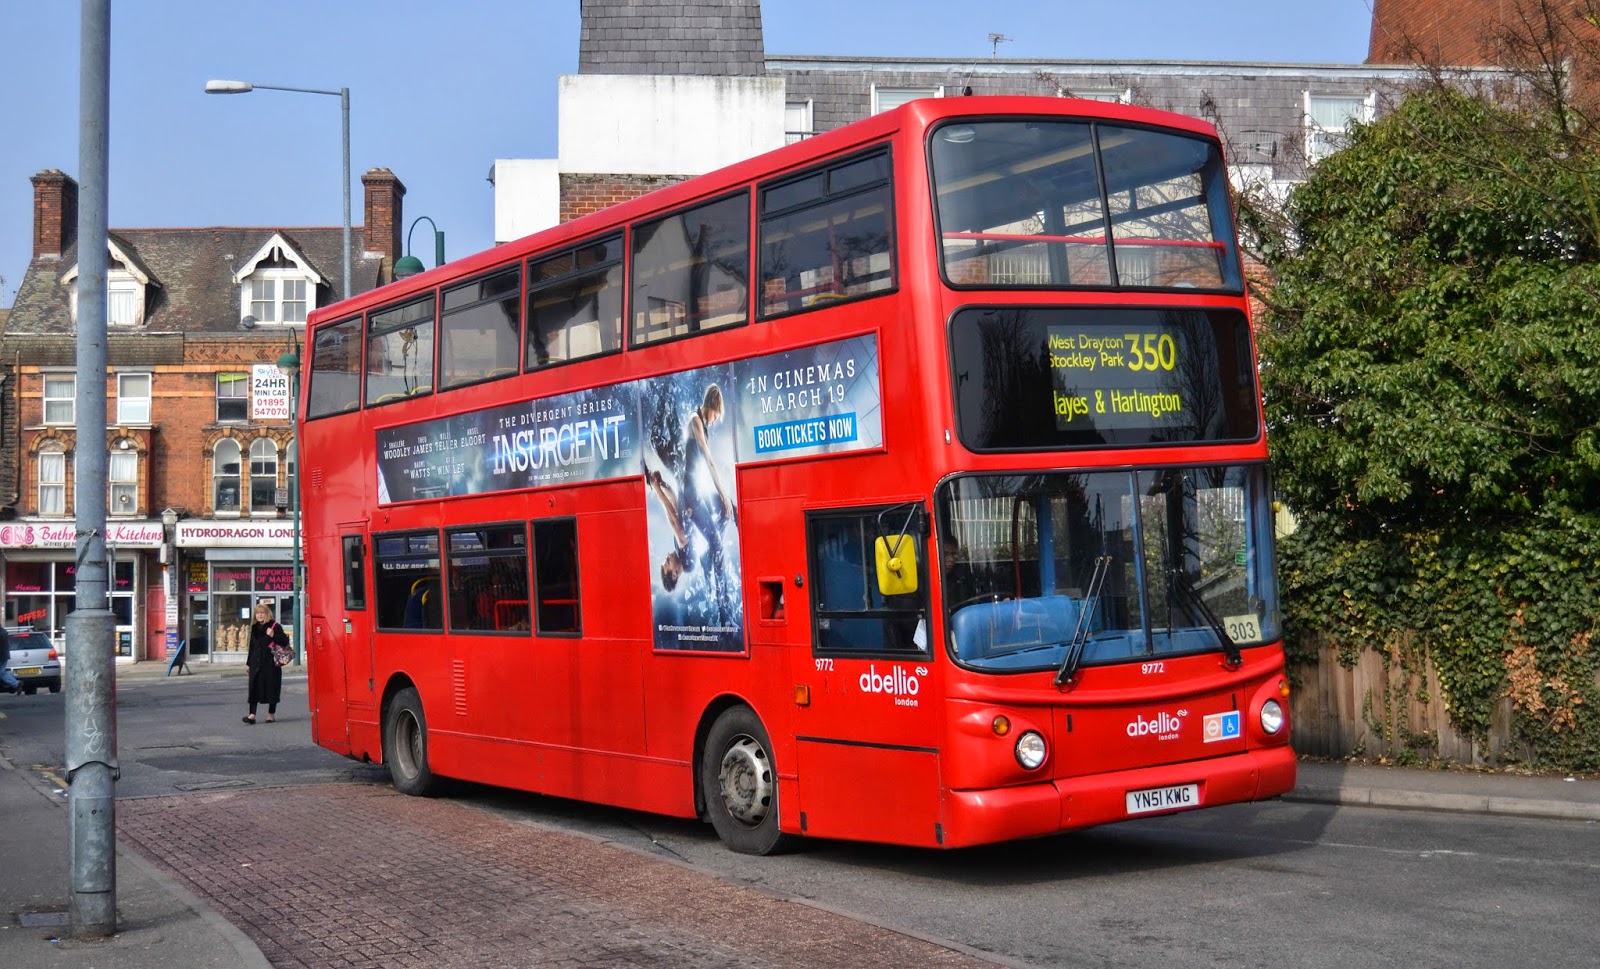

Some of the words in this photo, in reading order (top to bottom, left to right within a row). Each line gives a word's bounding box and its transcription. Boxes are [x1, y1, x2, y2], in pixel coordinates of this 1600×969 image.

[1078, 334, 1124, 352] Drayton
[1124, 334, 1176, 372] 350
[1100, 352, 1124, 367] Park
[255, 378, 286, 388] 24HR
[750, 375, 767, 394] IN
[774, 359, 856, 390] CINEMAS
[761, 388, 822, 414] MARCH
[828, 384, 845, 404] 19
[1094, 389, 1106, 414] &
[1110, 388, 1181, 418] Harlington
[500, 415, 516, 428] THE
[521, 406, 572, 426] DIVERGENT
[576, 398, 612, 416] SERIES
[758, 426, 784, 449] BOOK
[785, 421, 826, 446] TICKETS
[829, 417, 852, 440] NOW
[384, 446, 410, 460] WOODLEY
[412, 442, 432, 455] JAMES
[434, 438, 458, 452] TELLER
[460, 433, 486, 448] ELGORT
[492, 414, 626, 475] INSURGENT
[410, 468, 430, 480] WATTS
[116, 526, 162, 540] Kitchens
[182, 528, 264, 538] HYDRODRAGON
[18, 608, 47, 623] OFFERS
[1230, 621, 1256, 642] 303
[815, 658, 834, 672] 9772
[1142, 662, 1164, 674] 9772
[860, 664, 919, 696] abellio
[894, 697, 918, 707] london
[1126, 712, 1180, 738] abellio
[1158, 733, 1179, 741] london
[1134, 788, 1162, 809] YN51
[1166, 787, 1190, 805] KWG
